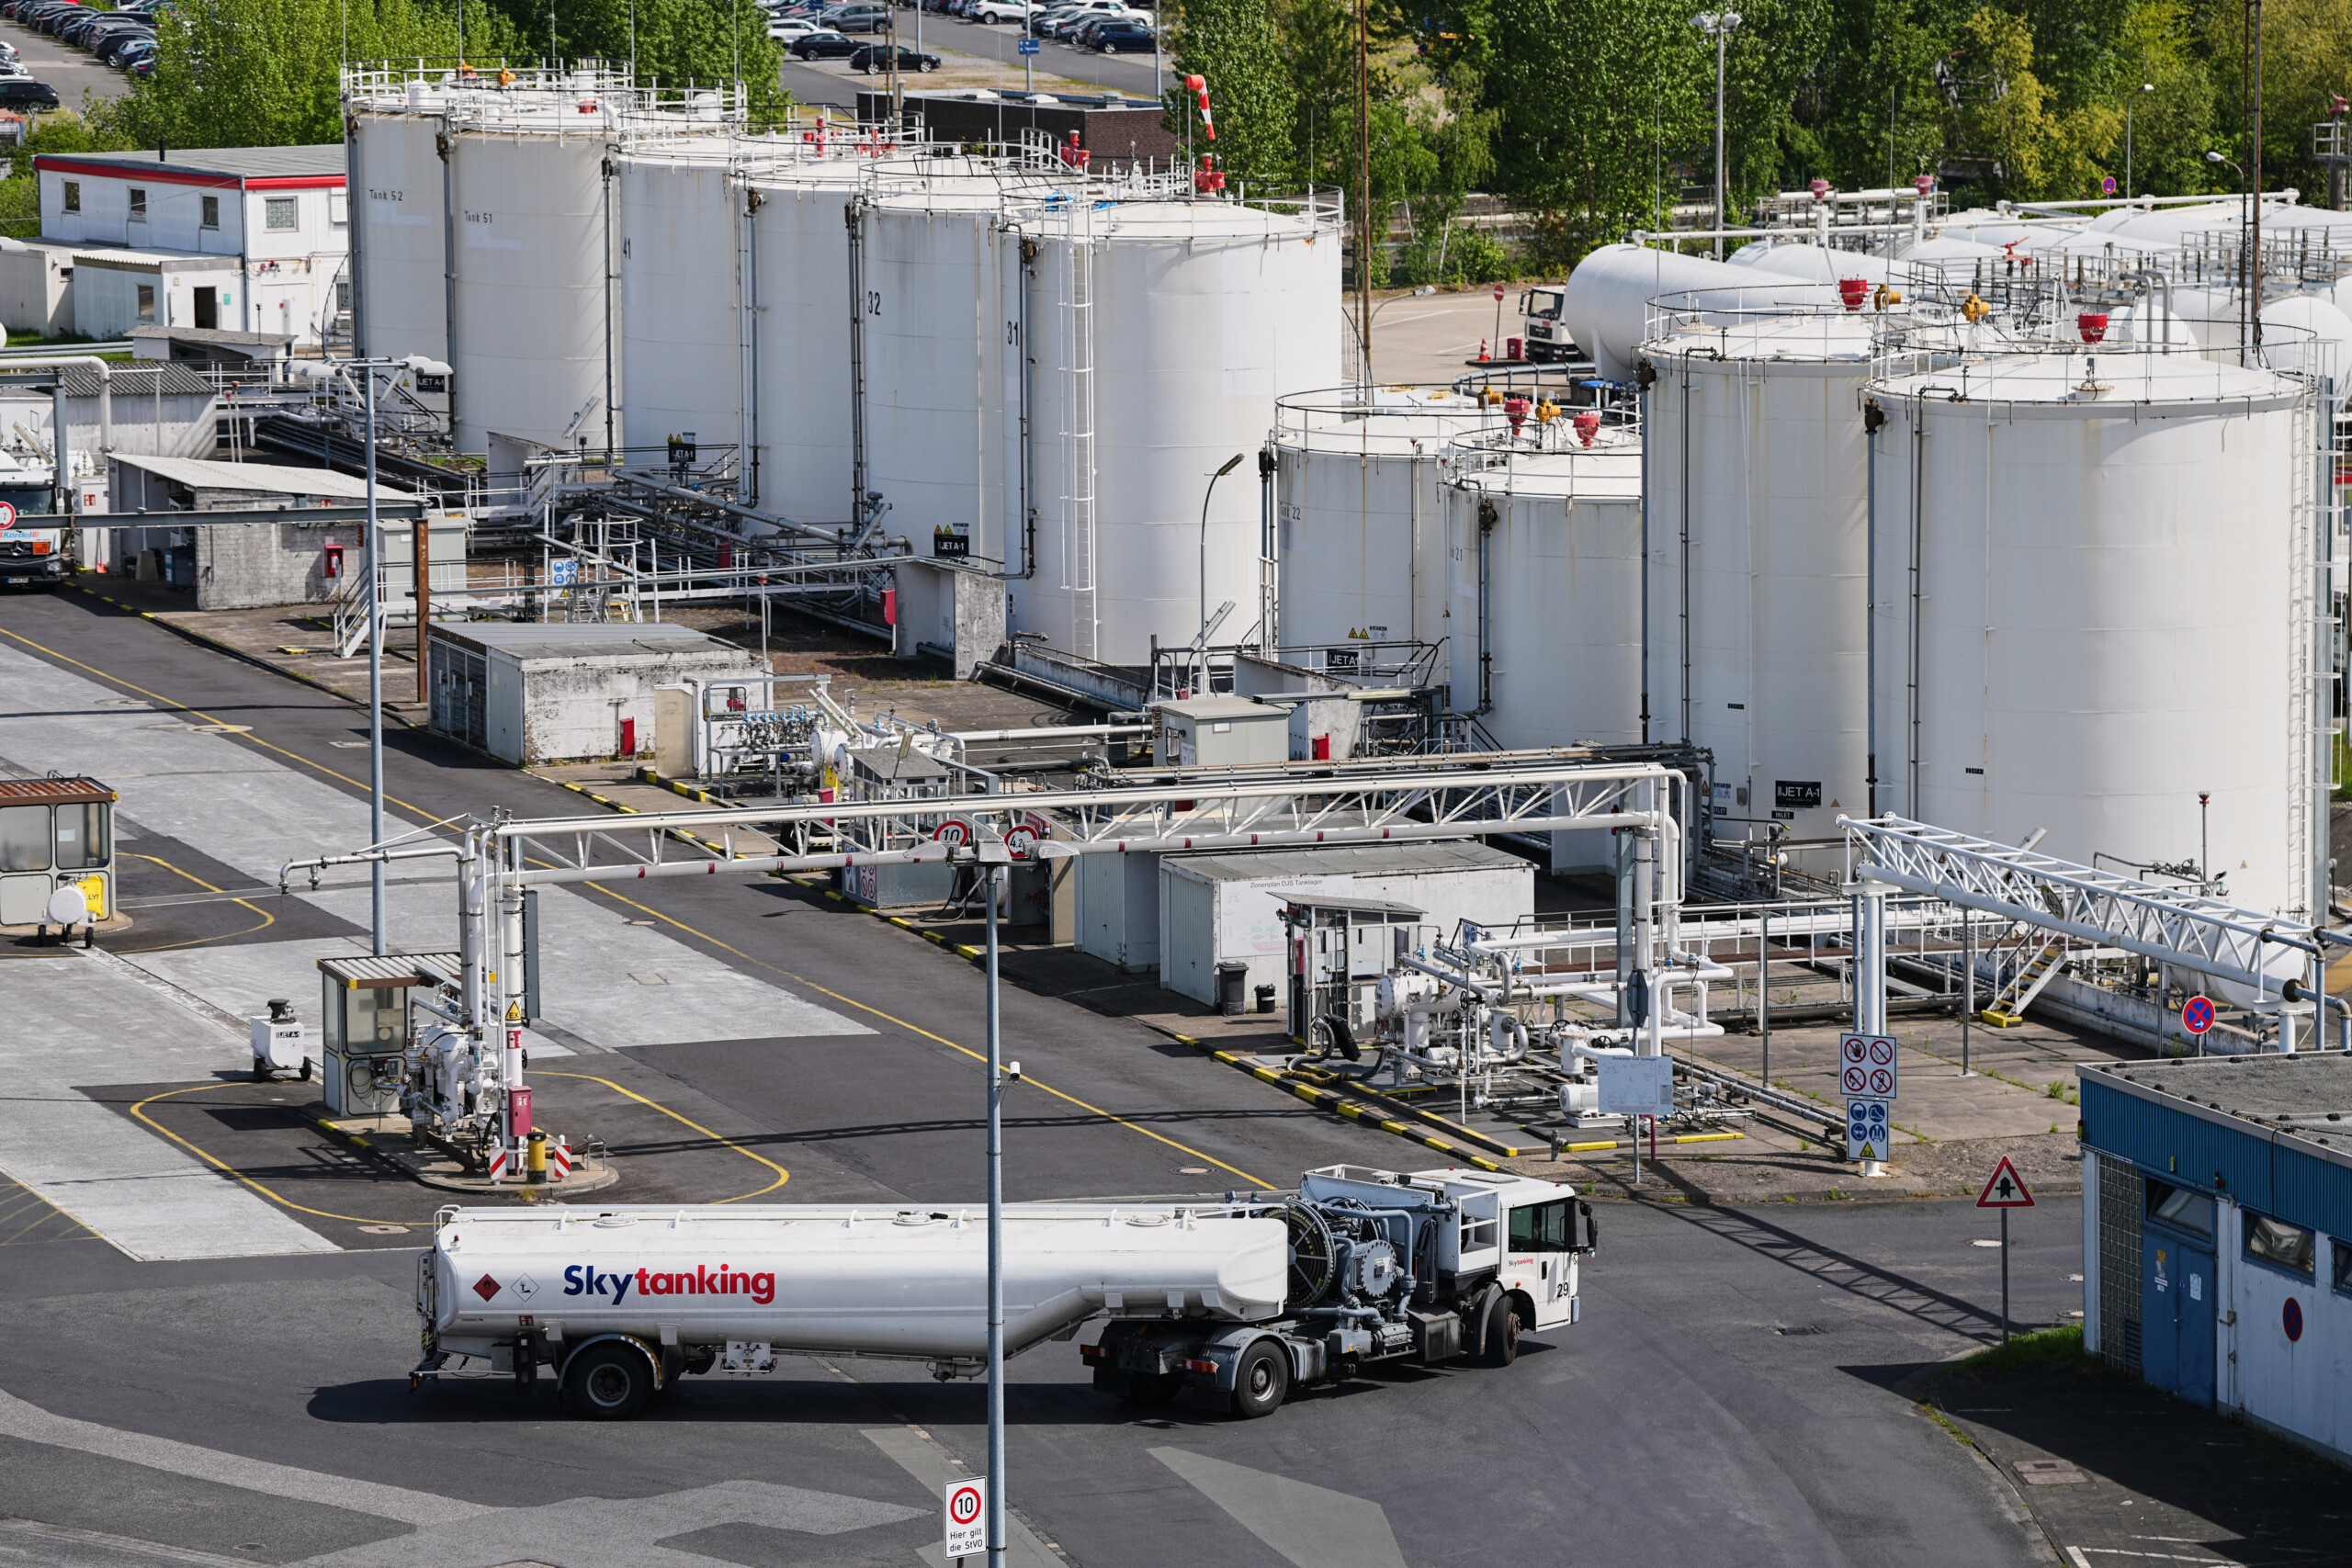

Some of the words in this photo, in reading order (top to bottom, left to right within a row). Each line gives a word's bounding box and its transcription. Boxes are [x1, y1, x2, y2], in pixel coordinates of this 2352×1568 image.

[369, 189, 387, 200] Tank
[391, 191, 402, 201] 52
[464, 210, 480, 222] Tank
[483, 212, 492, 223] 51
[868, 290, 880, 316] 32
[1007, 321, 1018, 346] 31
[1292, 506, 1301, 521] 22
[941, 542, 953, 550] JET
[954, 542, 965, 551] A-1
[1331, 655, 1349, 665] JET
[1805, 787, 1820, 798] A-1
[943, 829, 960, 841] 10
[1508, 1258, 1534, 1267] Skytanking
[563, 1264, 775, 1305] Skytanking
[1556, 1282, 1569, 1298] 29
[958, 1496, 974, 1515] 10
[950, 1531, 967, 1540] Hier
[969, 1528, 982, 1539] gilt
[950, 1543, 962, 1552] die
[965, 1539, 983, 1550] StVO
